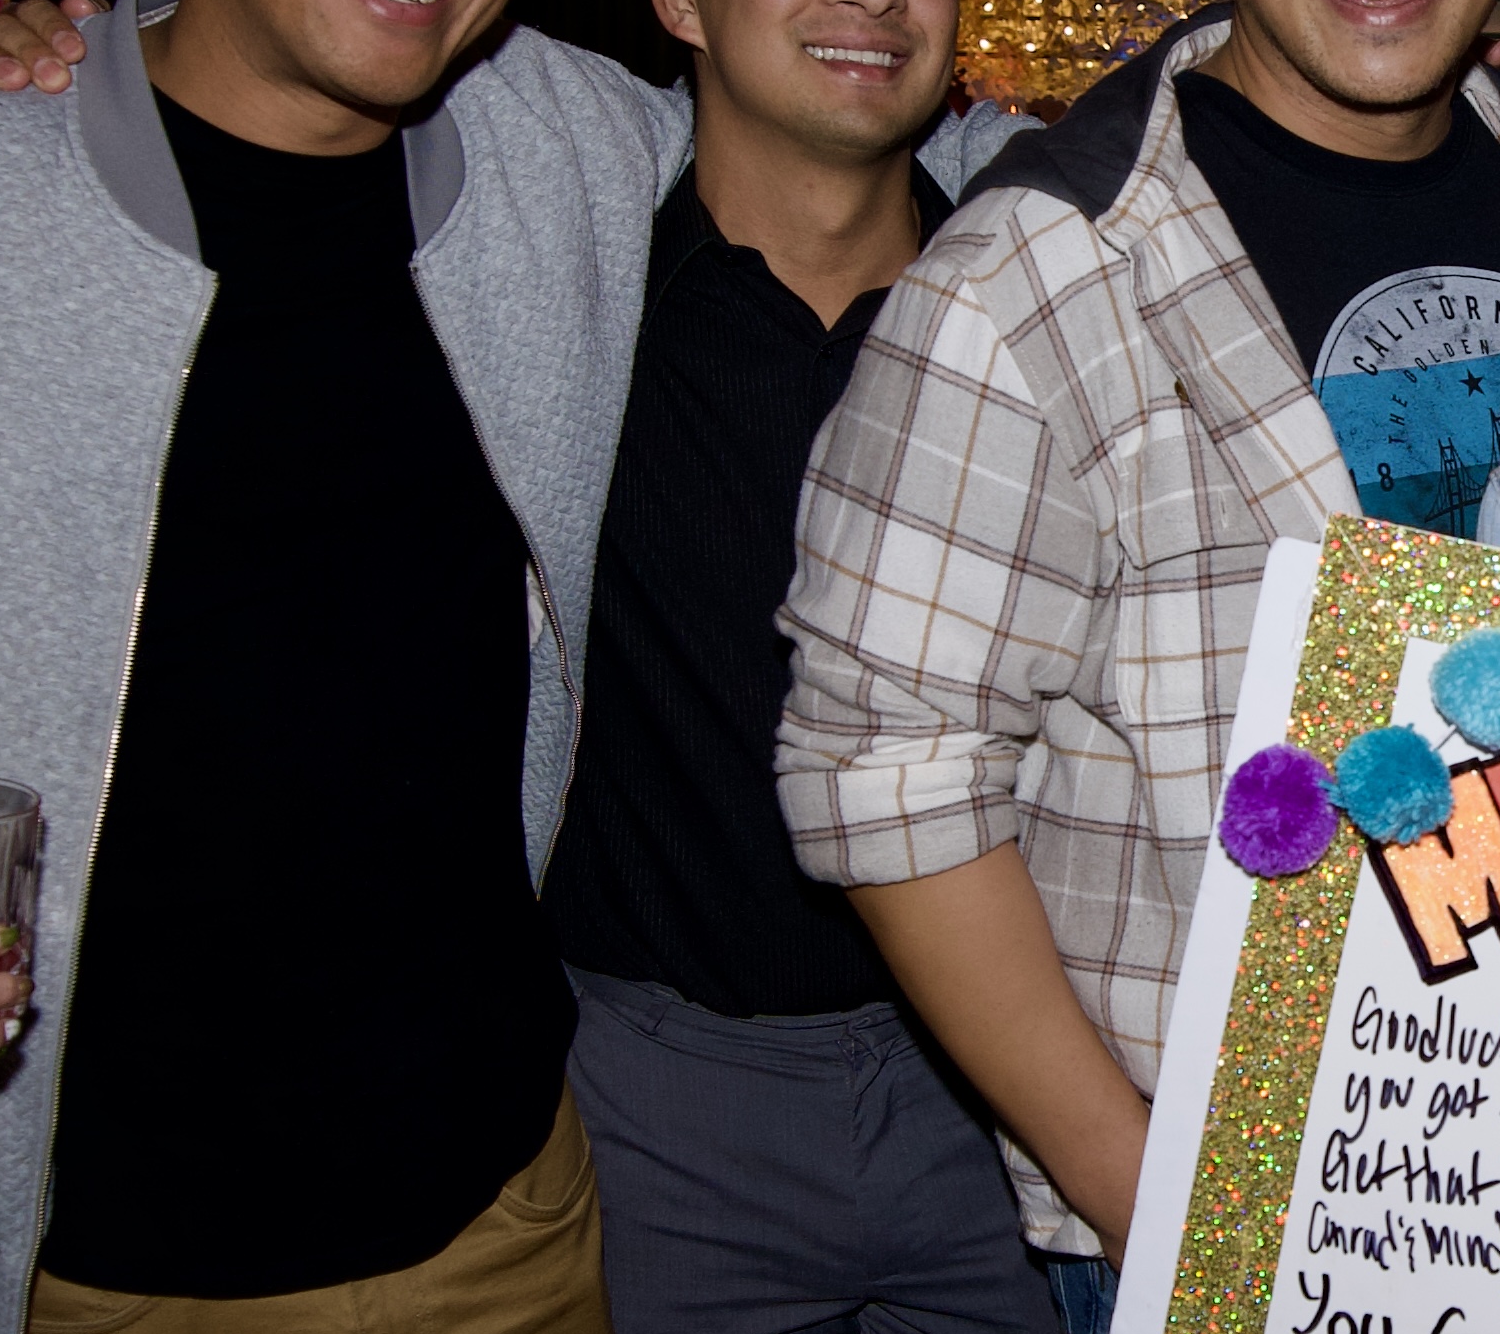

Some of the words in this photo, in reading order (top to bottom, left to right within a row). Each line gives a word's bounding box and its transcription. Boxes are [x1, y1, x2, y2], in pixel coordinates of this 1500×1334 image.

[1388, 394, 1408, 444] THE
[1404, 339, 1490, 383] GOLDEN
[1424, 1077, 1488, 1140] got
